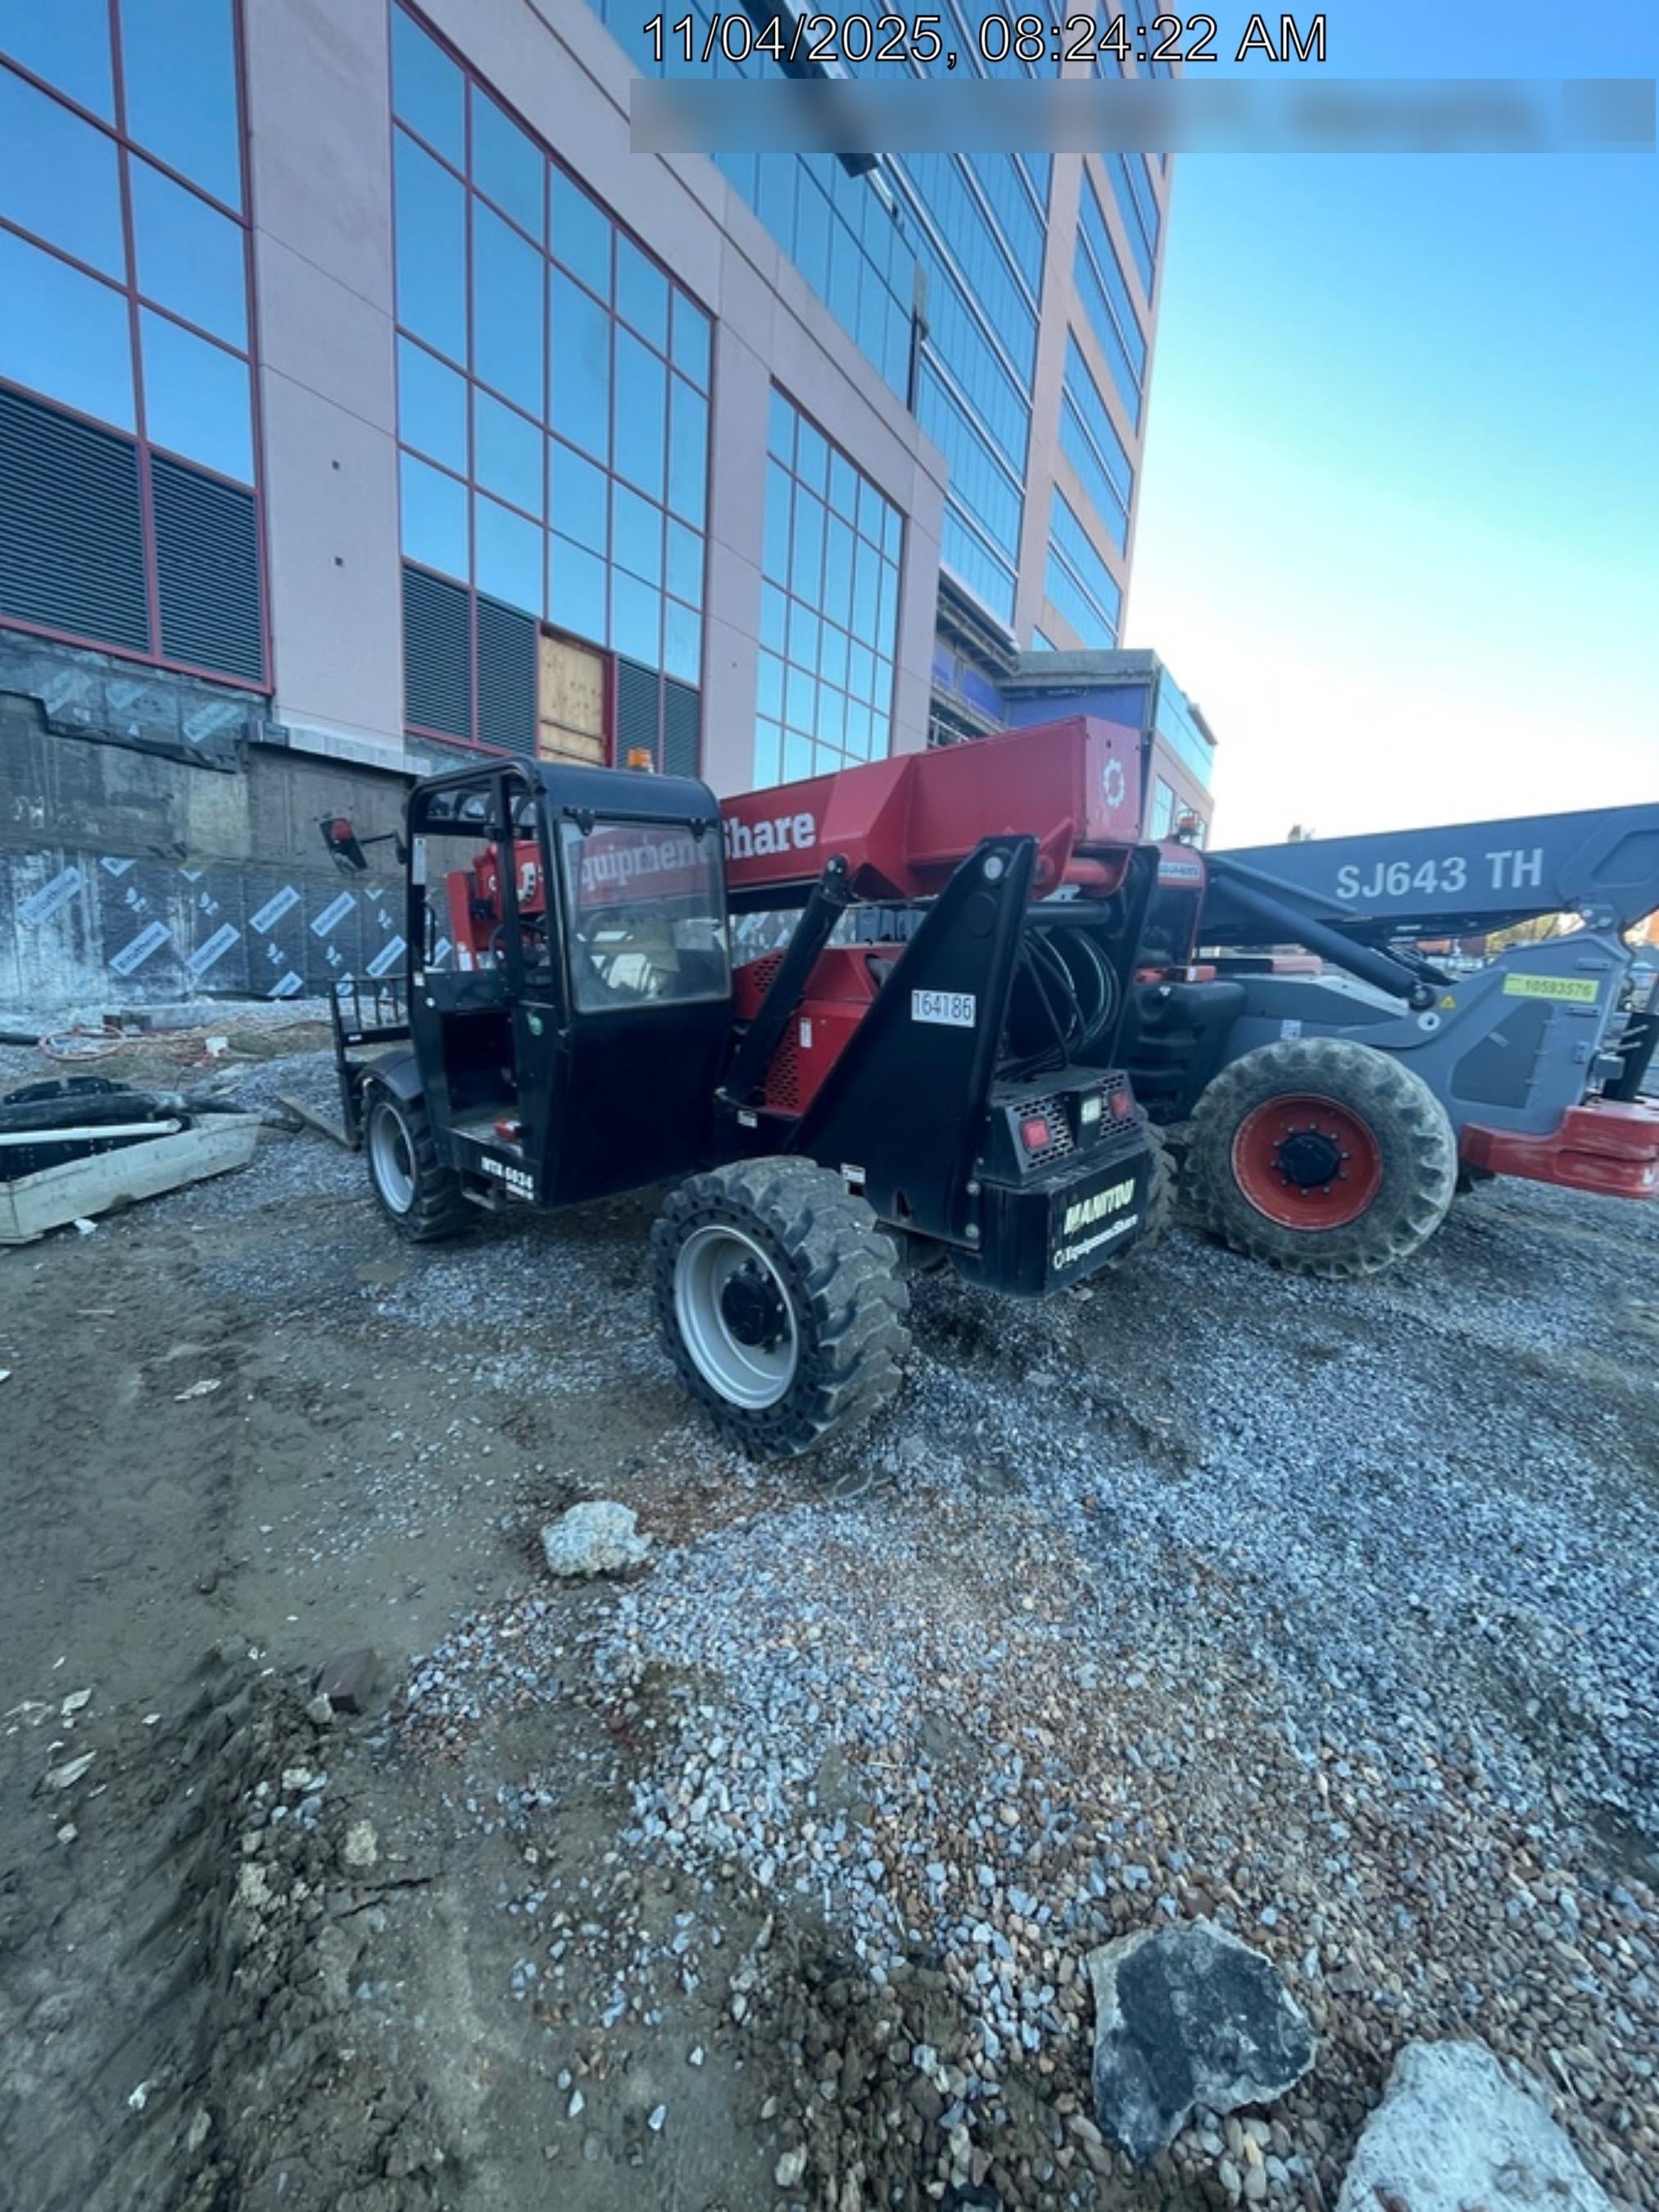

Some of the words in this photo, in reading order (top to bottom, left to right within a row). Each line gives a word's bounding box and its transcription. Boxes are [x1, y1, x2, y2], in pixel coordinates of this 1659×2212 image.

[1335, 857, 1468, 899] SJ643
[1484, 848, 1543, 890] TH
[913, 993, 972, 1021] 164186
